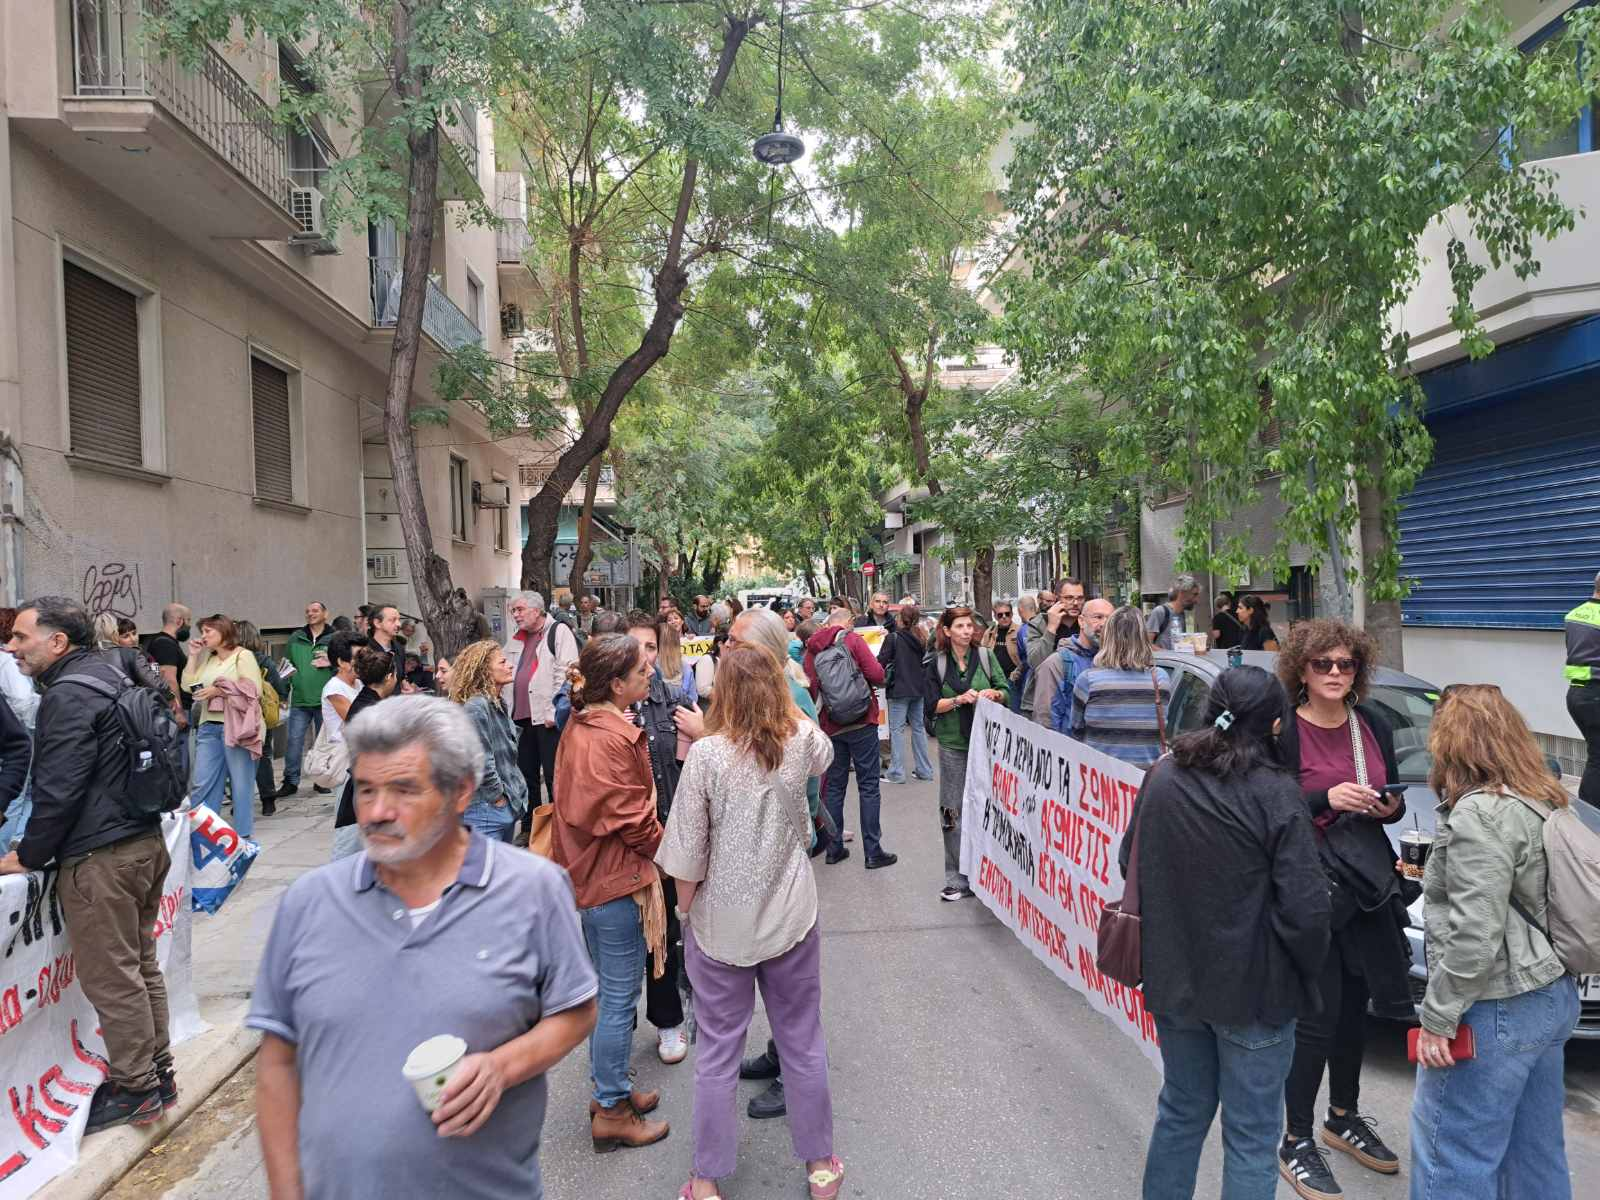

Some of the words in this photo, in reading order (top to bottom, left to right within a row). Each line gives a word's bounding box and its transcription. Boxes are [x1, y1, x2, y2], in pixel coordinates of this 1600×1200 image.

[1002, 728, 1012, 764] ΤΑ
[1013, 733, 1034, 783] ΧΕΡΙΑ
[1033, 746, 1052, 790] ΑΠΟ
[1058, 756, 1070, 805] ΤΑ
[983, 798, 991, 831] Η
[1039, 852, 1055, 900] ΔΕΝ
[1058, 867, 1079, 925] ΘΑ
[1041, 799, 1111, 886] ΑΓΩΝΙΣΤΕΣ
[978, 854, 1014, 918] ΕΝΟΤΗΤΑ
